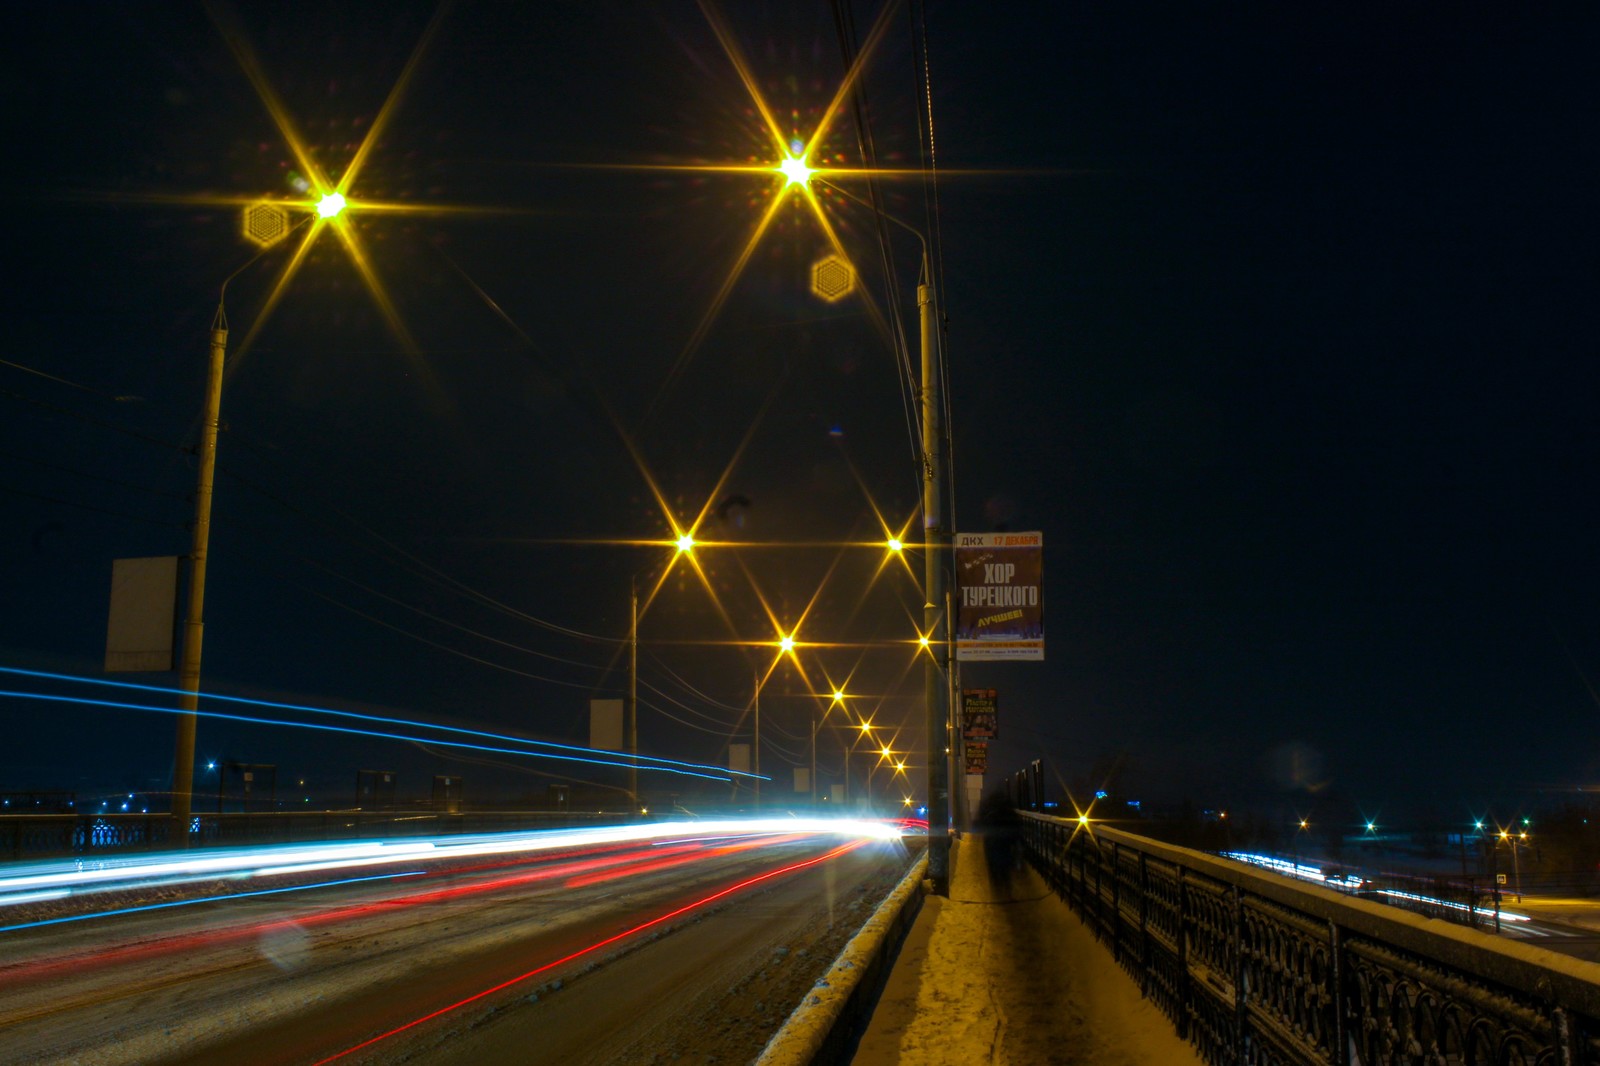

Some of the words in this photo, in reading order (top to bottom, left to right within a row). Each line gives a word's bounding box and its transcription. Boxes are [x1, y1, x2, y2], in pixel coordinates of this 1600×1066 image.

[962, 537, 983, 547] ДКХ
[994, 536, 1003, 546] 17
[1005, 536, 1039, 546] ДЕКАБРЯ
[984, 563, 1015, 584] ХОР
[961, 586, 1038, 607] ТУРЕЦКОГО
[977, 609, 1023, 627] ЛУЧШЕЕ!
